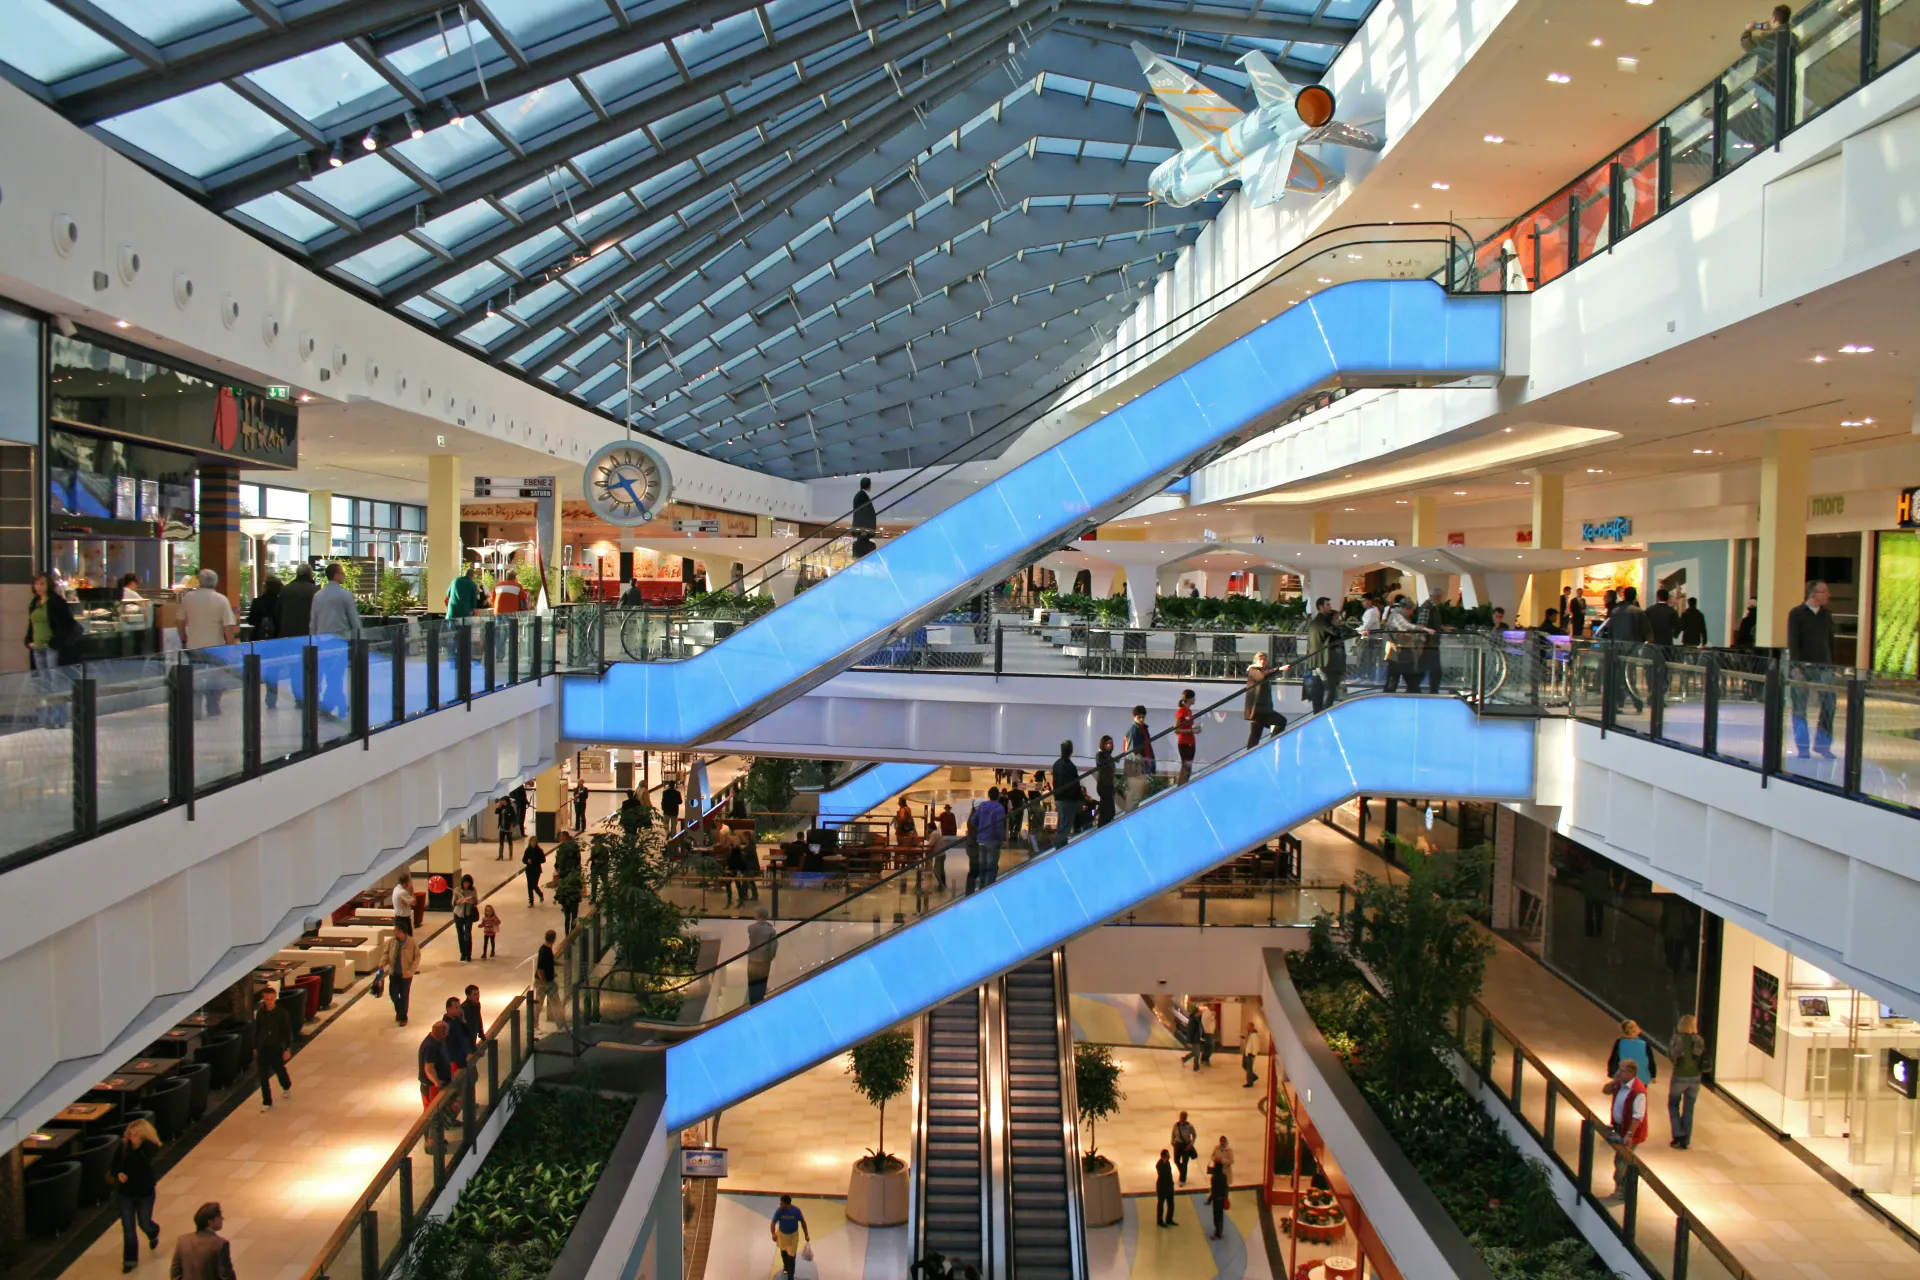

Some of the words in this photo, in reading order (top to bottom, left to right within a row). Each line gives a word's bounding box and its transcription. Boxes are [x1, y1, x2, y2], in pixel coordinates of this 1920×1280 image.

[523, 478, 548, 486] EBENE
[548, 479, 553, 487] 2
[1812, 496, 1845, 516] more
